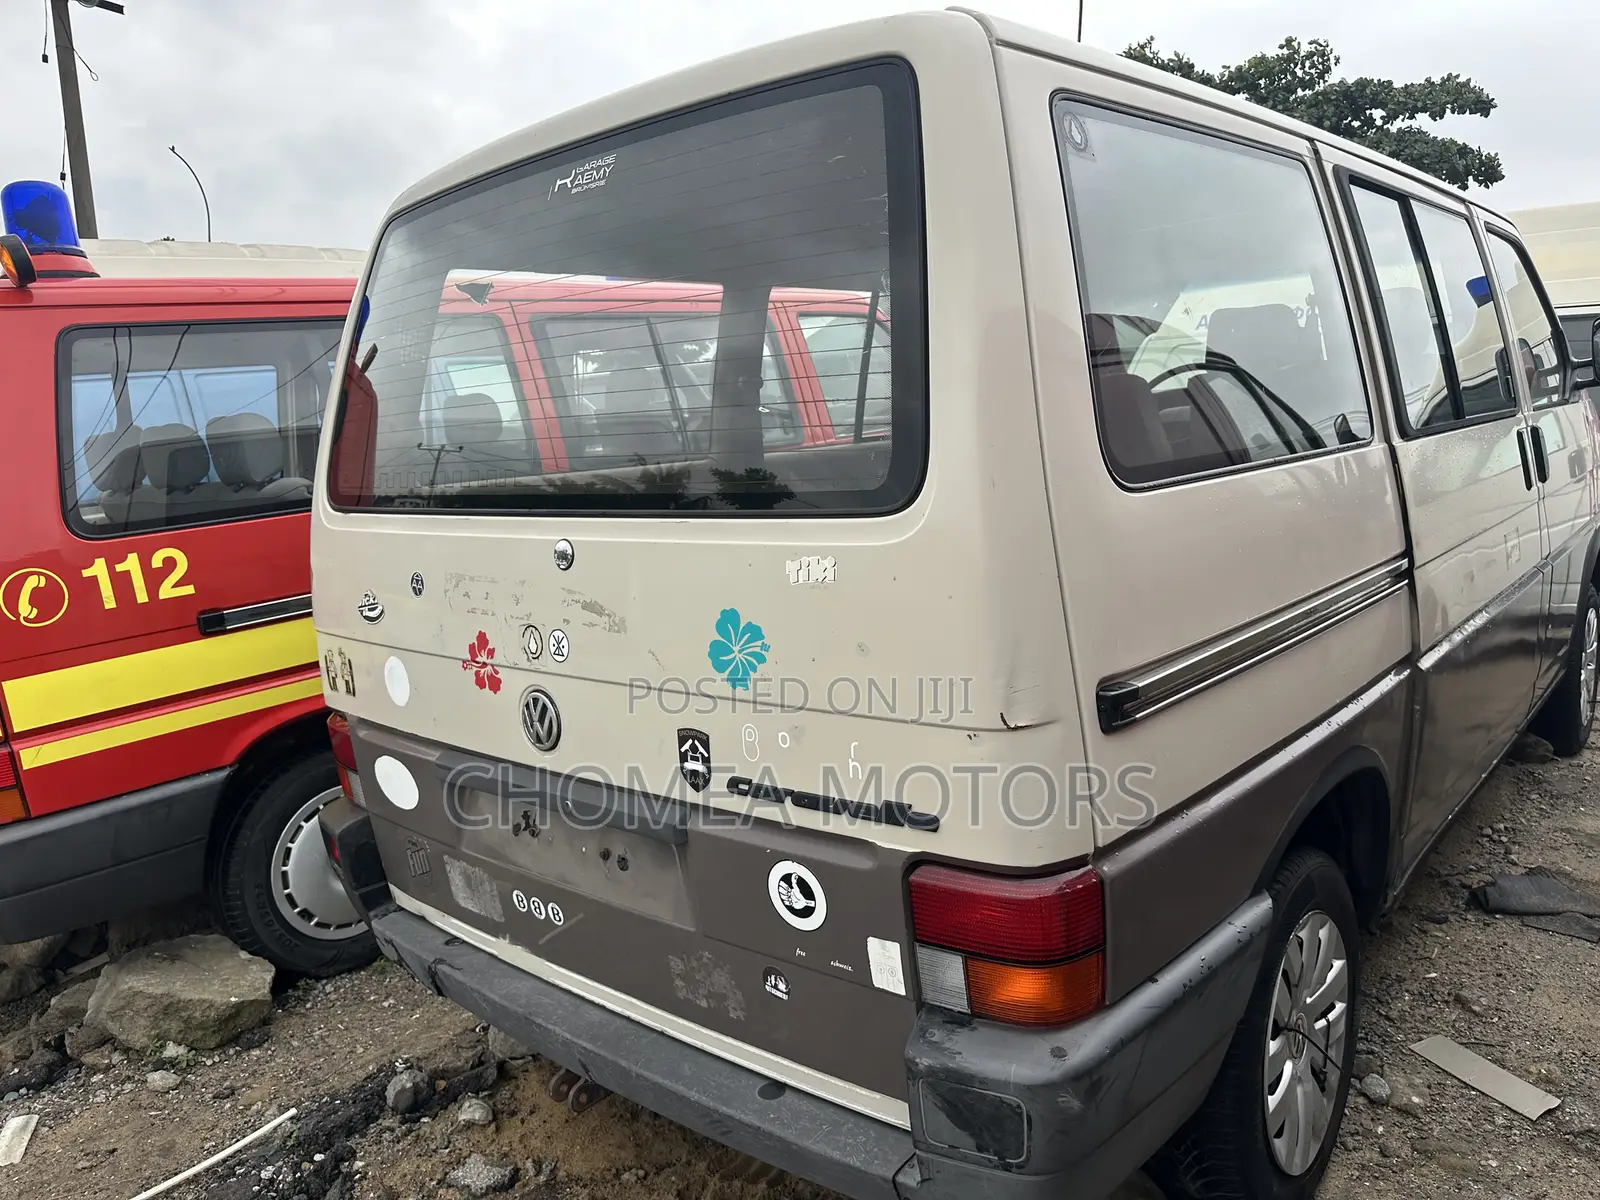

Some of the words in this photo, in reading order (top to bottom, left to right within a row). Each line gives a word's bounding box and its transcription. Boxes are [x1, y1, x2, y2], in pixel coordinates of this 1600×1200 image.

[577, 154, 616, 173] GARAGE
[81, 547, 196, 610] 112
[678, 730, 708, 742] SNOWPARK
